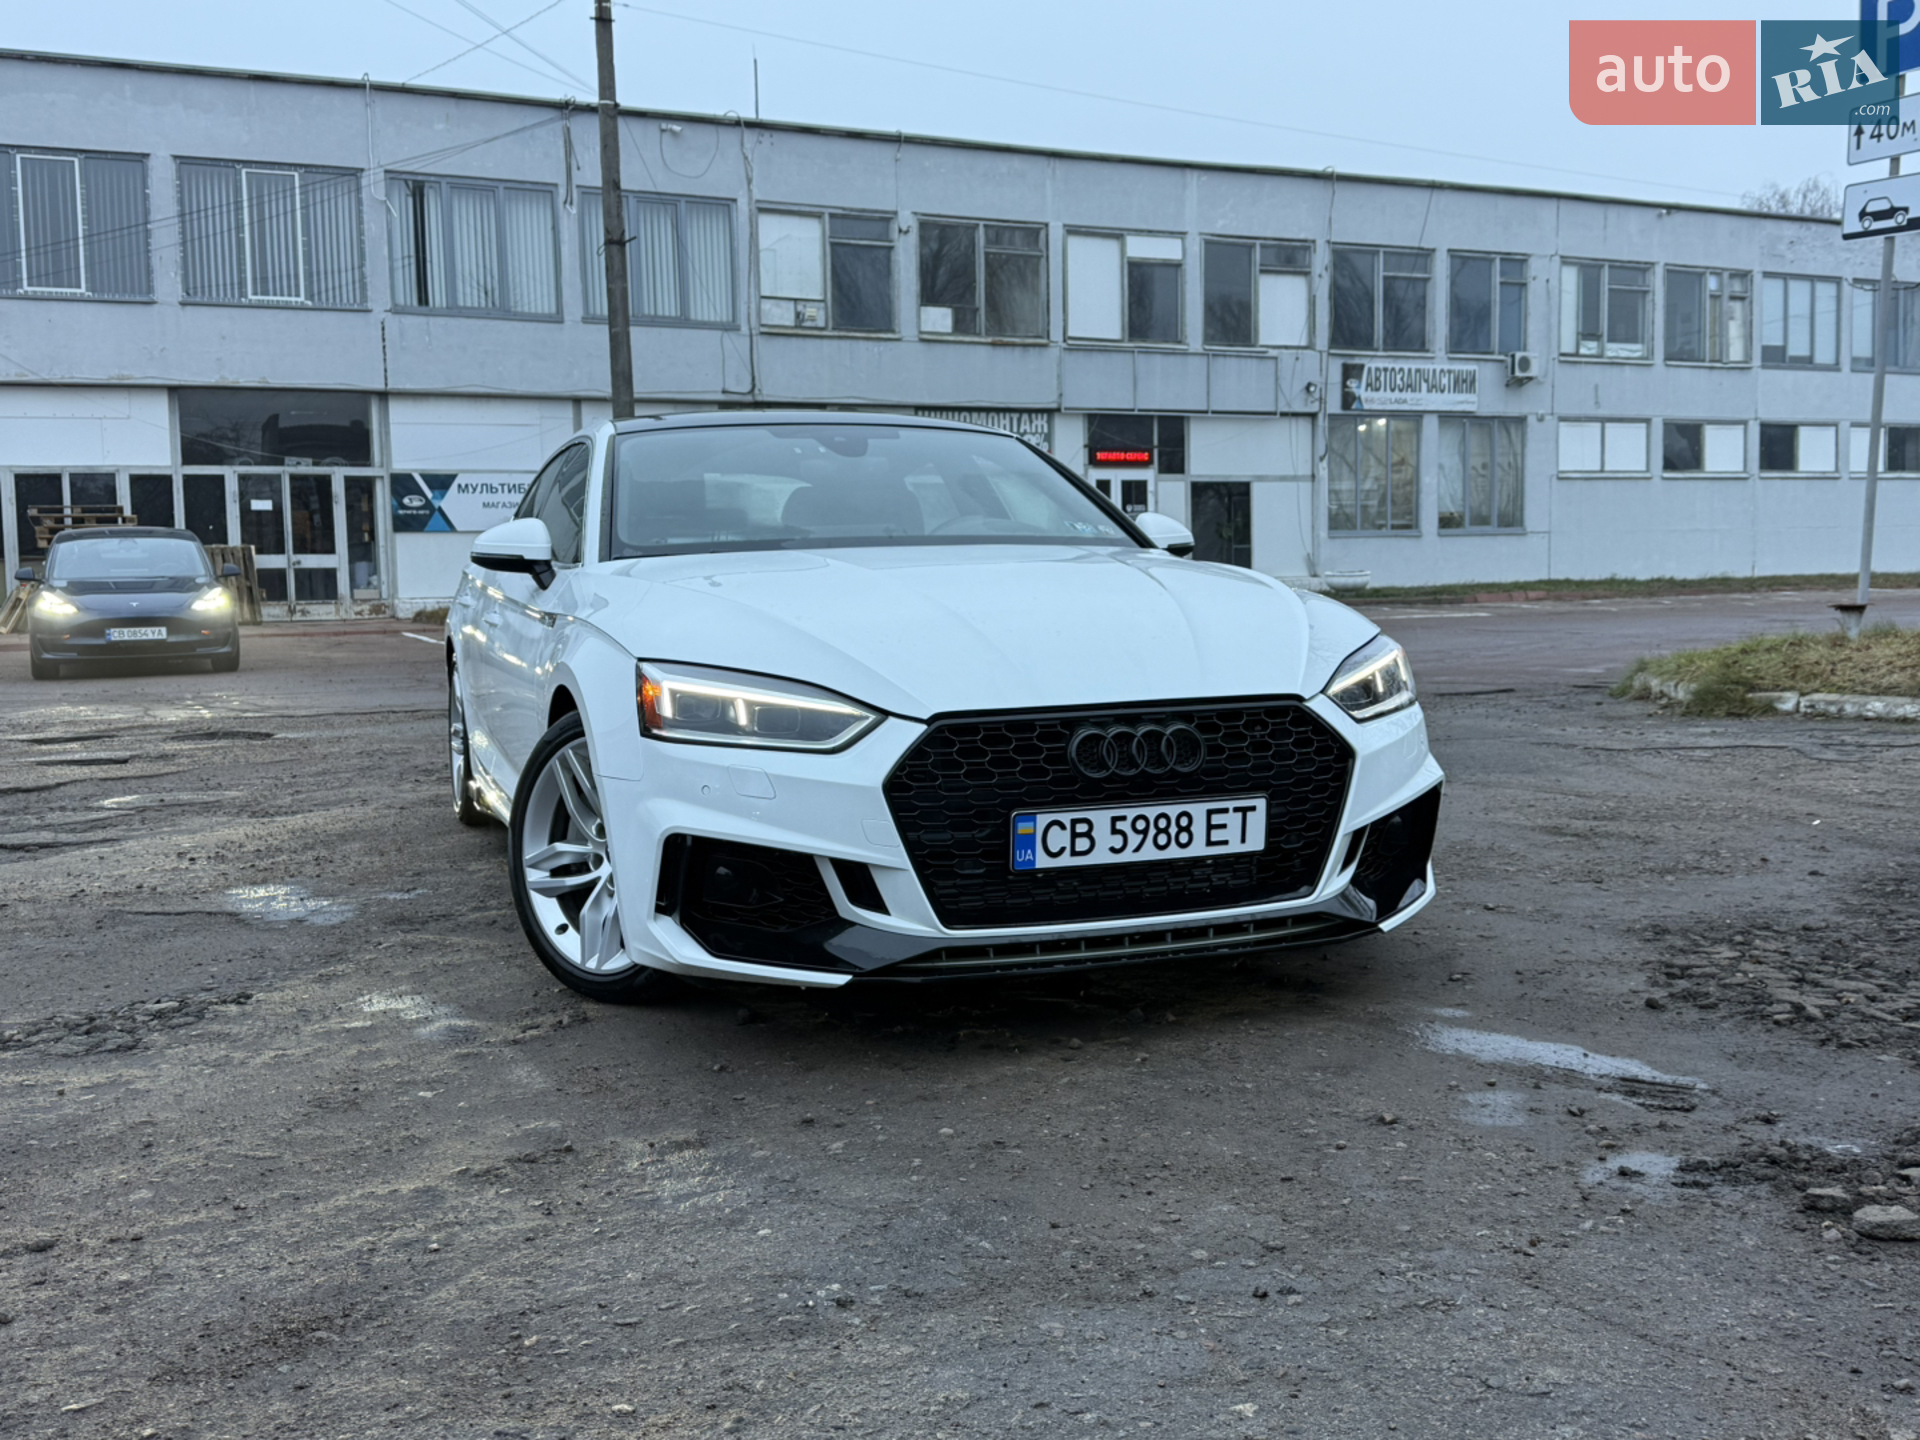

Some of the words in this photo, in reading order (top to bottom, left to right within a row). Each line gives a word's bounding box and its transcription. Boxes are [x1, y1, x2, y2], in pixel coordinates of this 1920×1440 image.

[1365, 366, 1477, 394] АВТОЗАПЧАСТИНИ
[457, 483, 530, 495] МУЛЬТИБ
[1041, 817, 1096, 859] CB
[1108, 810, 1194, 855] 5988
[1205, 805, 1257, 847] ET
[1016, 848, 1034, 862] UA
